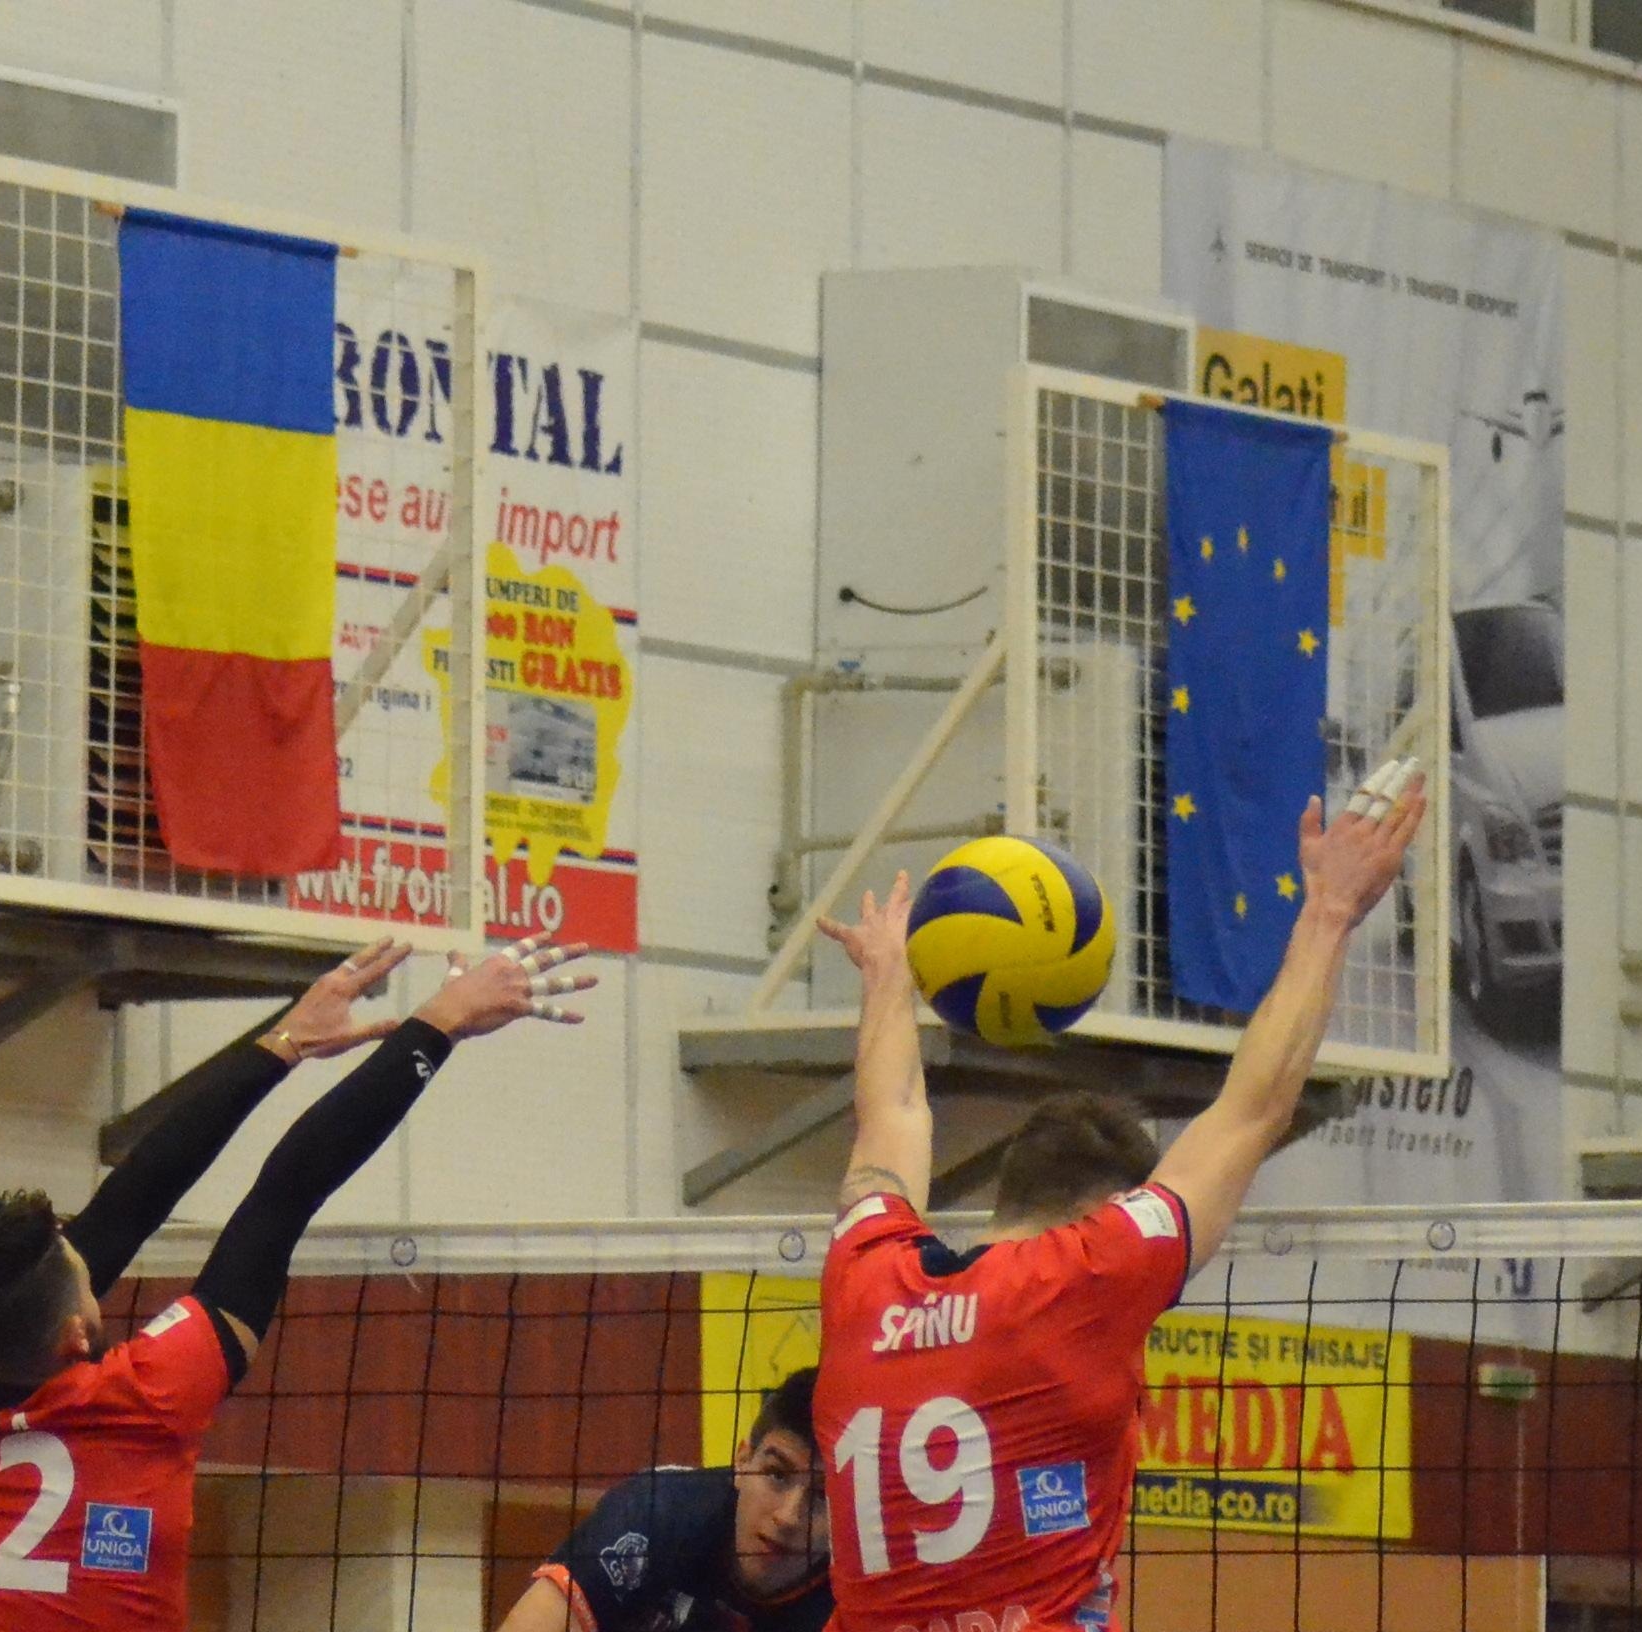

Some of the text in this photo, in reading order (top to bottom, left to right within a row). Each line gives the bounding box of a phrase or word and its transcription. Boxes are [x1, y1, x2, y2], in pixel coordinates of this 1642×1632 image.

[497, 486, 620, 567] import
[1279, 1335, 1386, 1371] FINISAJE
[833, 1395, 996, 1576] 19
[86, 1538, 143, 1557] UNIQA
